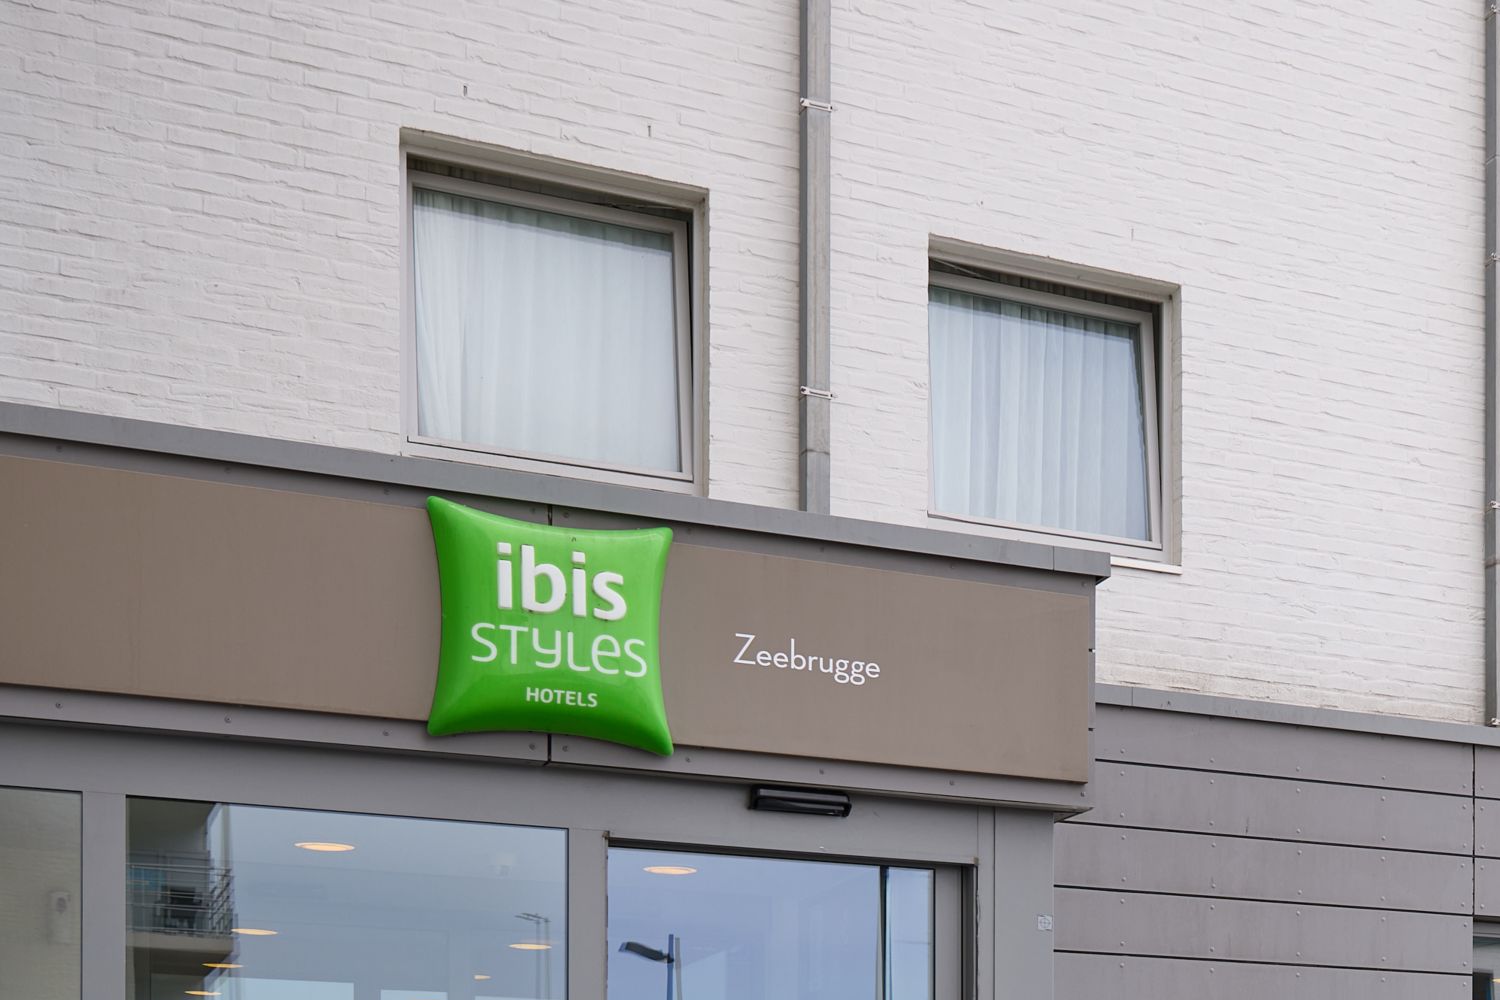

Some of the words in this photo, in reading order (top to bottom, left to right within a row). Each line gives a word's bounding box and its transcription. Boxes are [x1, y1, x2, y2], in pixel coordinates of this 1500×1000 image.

[497, 542, 627, 621] ibis
[733, 633, 881, 686] Zeebrugge
[526, 687, 598, 708] HOTELS
